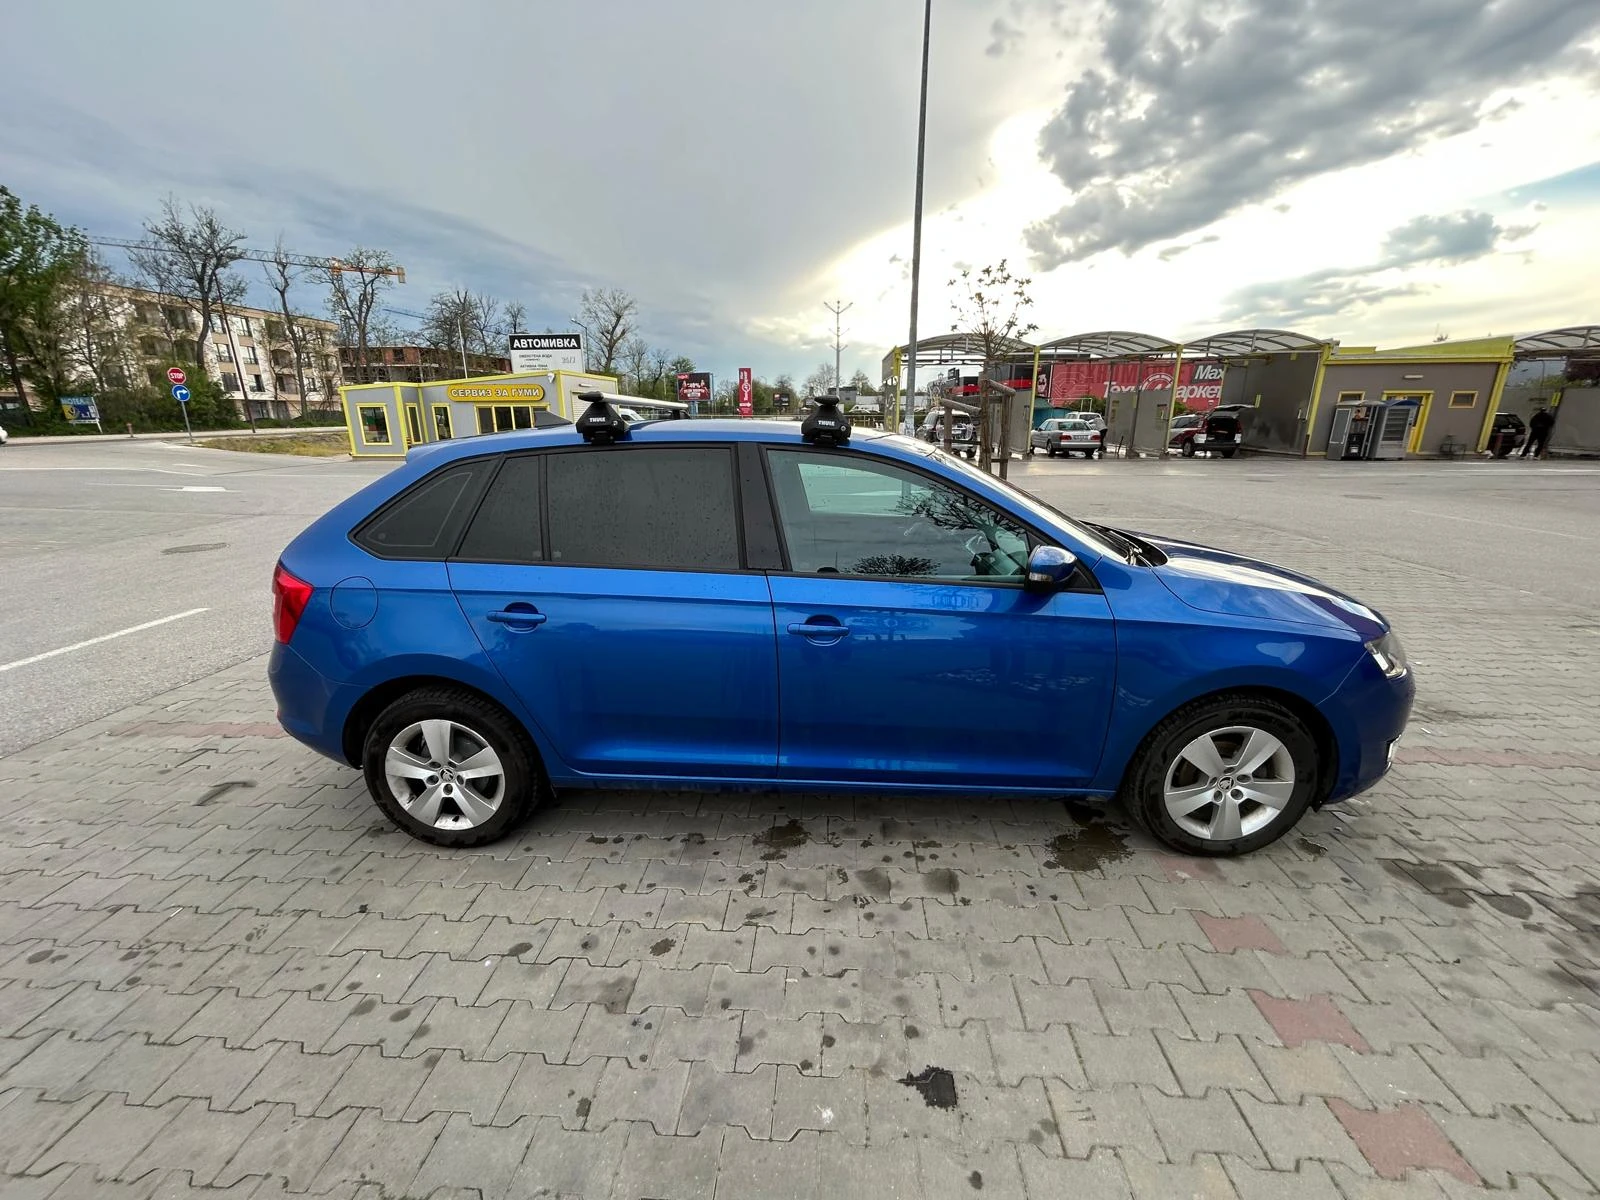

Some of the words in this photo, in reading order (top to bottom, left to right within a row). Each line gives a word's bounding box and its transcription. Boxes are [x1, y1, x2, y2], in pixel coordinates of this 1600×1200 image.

[513, 338, 578, 349] АВТОМИВКА
[1194, 364, 1225, 380] Max
[451, 389, 492, 397] СЕРВИЗ
[495, 389, 509, 397] ЗА
[511, 388, 540, 397] ГУМИ
